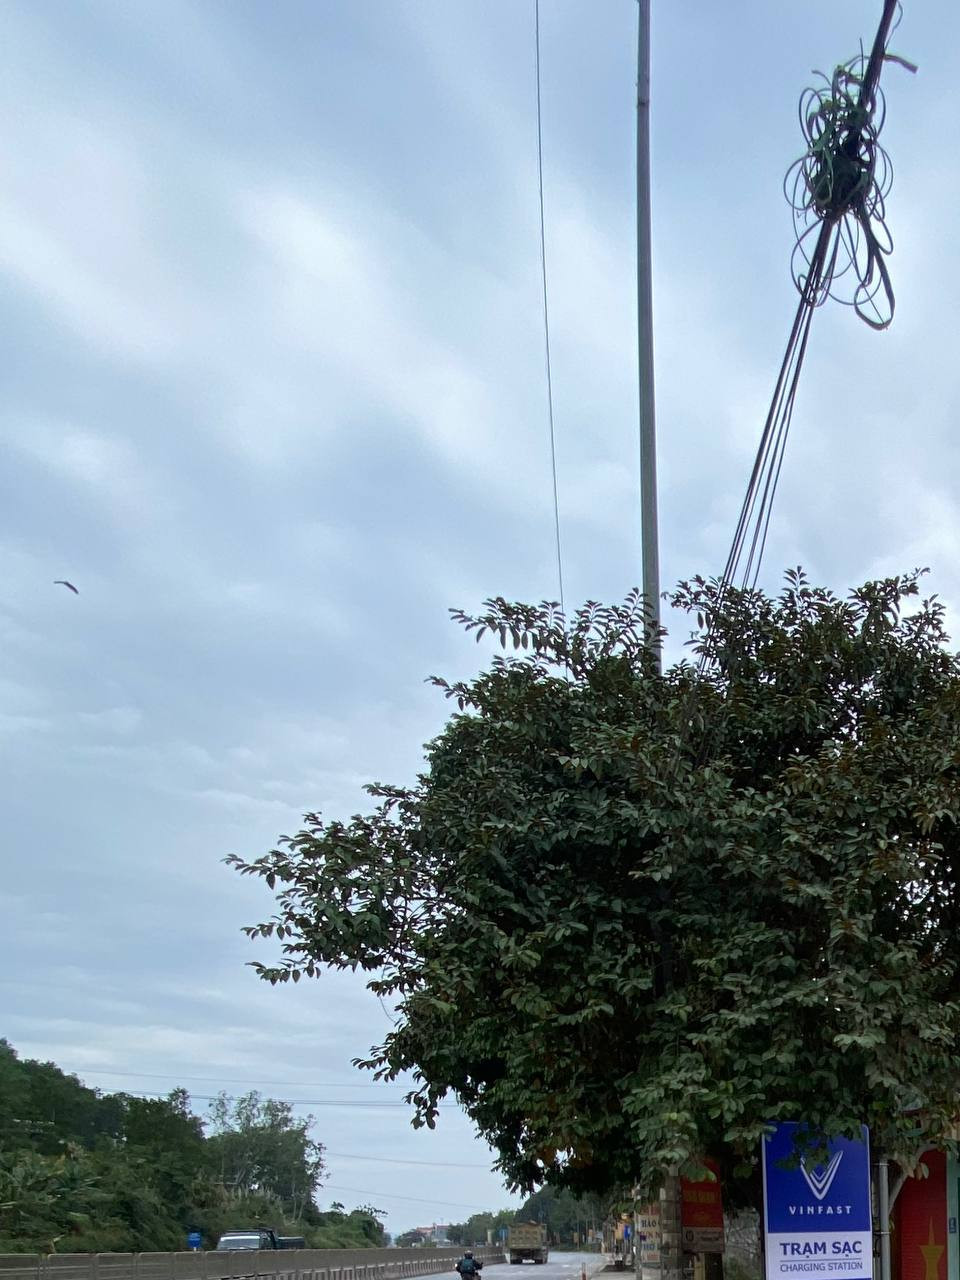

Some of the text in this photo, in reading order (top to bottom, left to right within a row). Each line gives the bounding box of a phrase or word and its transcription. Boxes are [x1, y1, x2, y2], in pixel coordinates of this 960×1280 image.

[788, 1205, 852, 1215] VINFAST
[779, 1240, 863, 1259] TRẠM SẠC
[780, 1261, 863, 1273] CHARGING STATION
